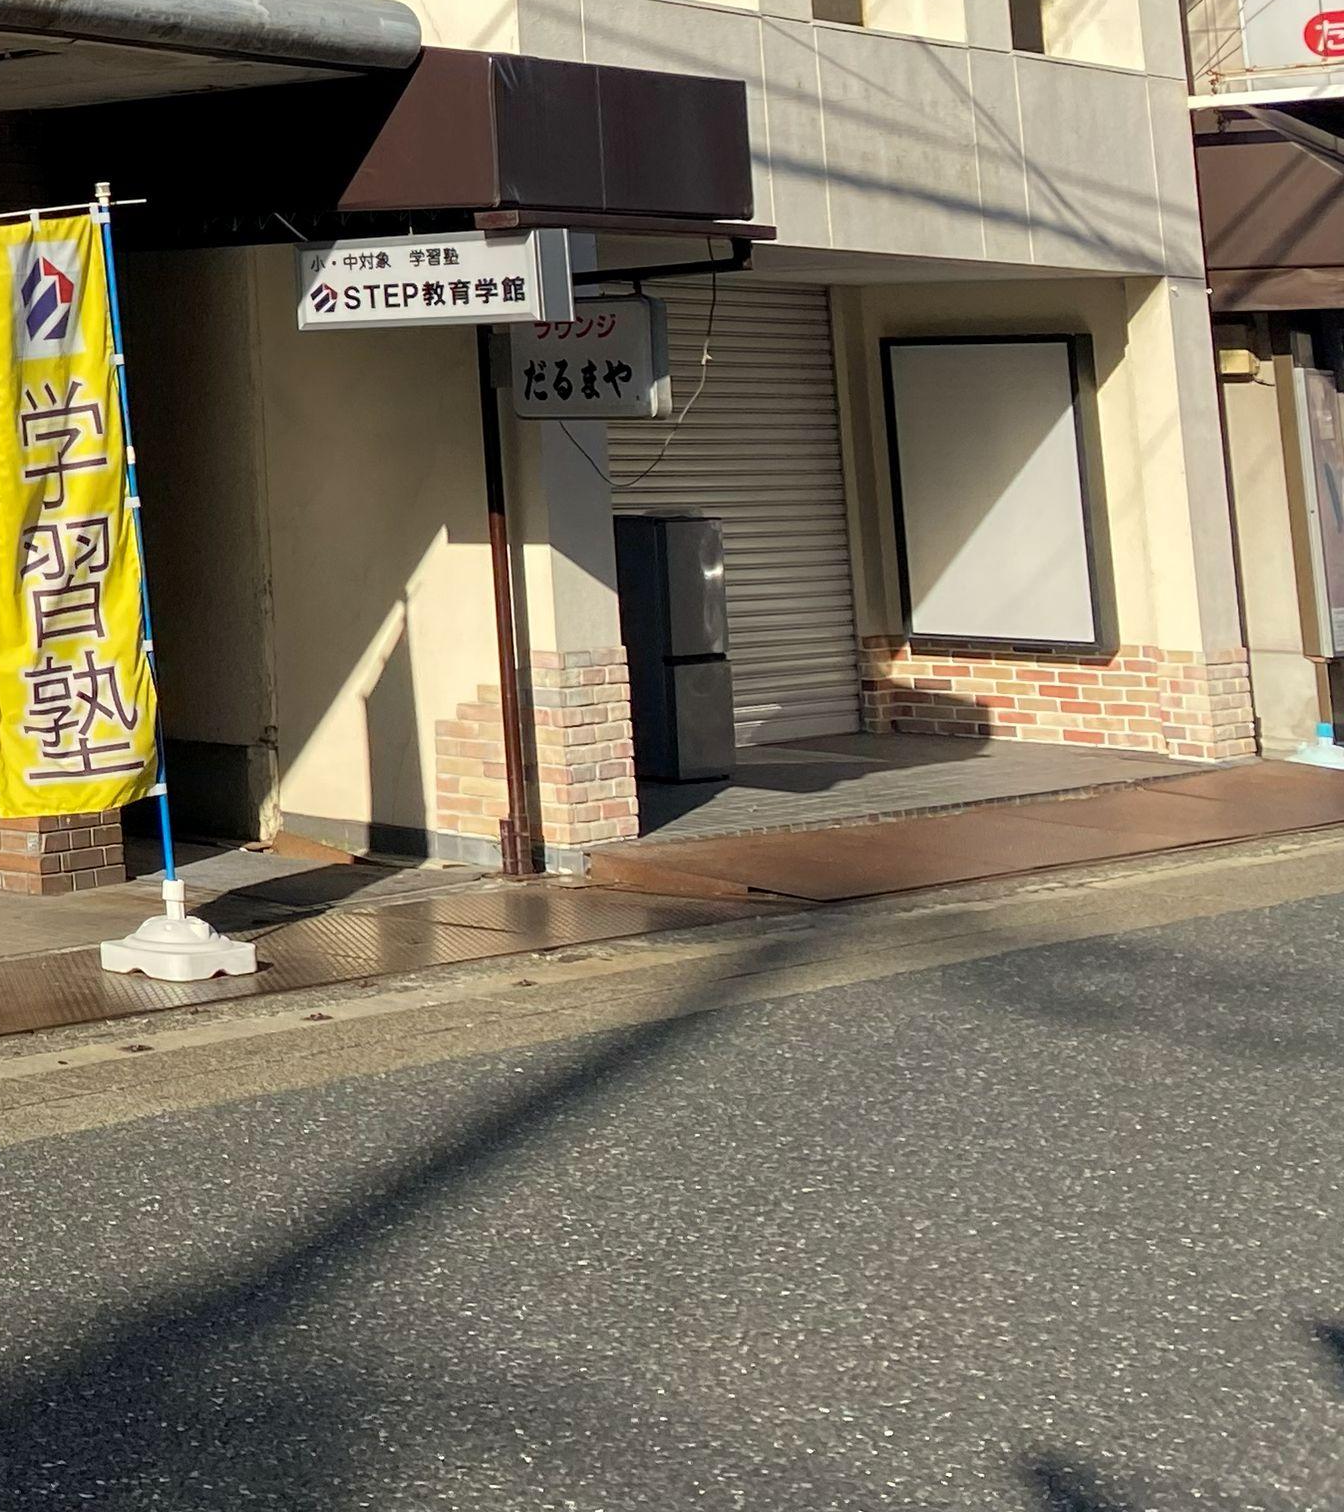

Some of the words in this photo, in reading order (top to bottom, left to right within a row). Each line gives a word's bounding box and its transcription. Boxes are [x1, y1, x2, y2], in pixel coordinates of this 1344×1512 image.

[409, 247, 461, 268] 学習塾
[524, 358, 633, 401] だるまや
[20, 380, 146, 781] 学習塾
